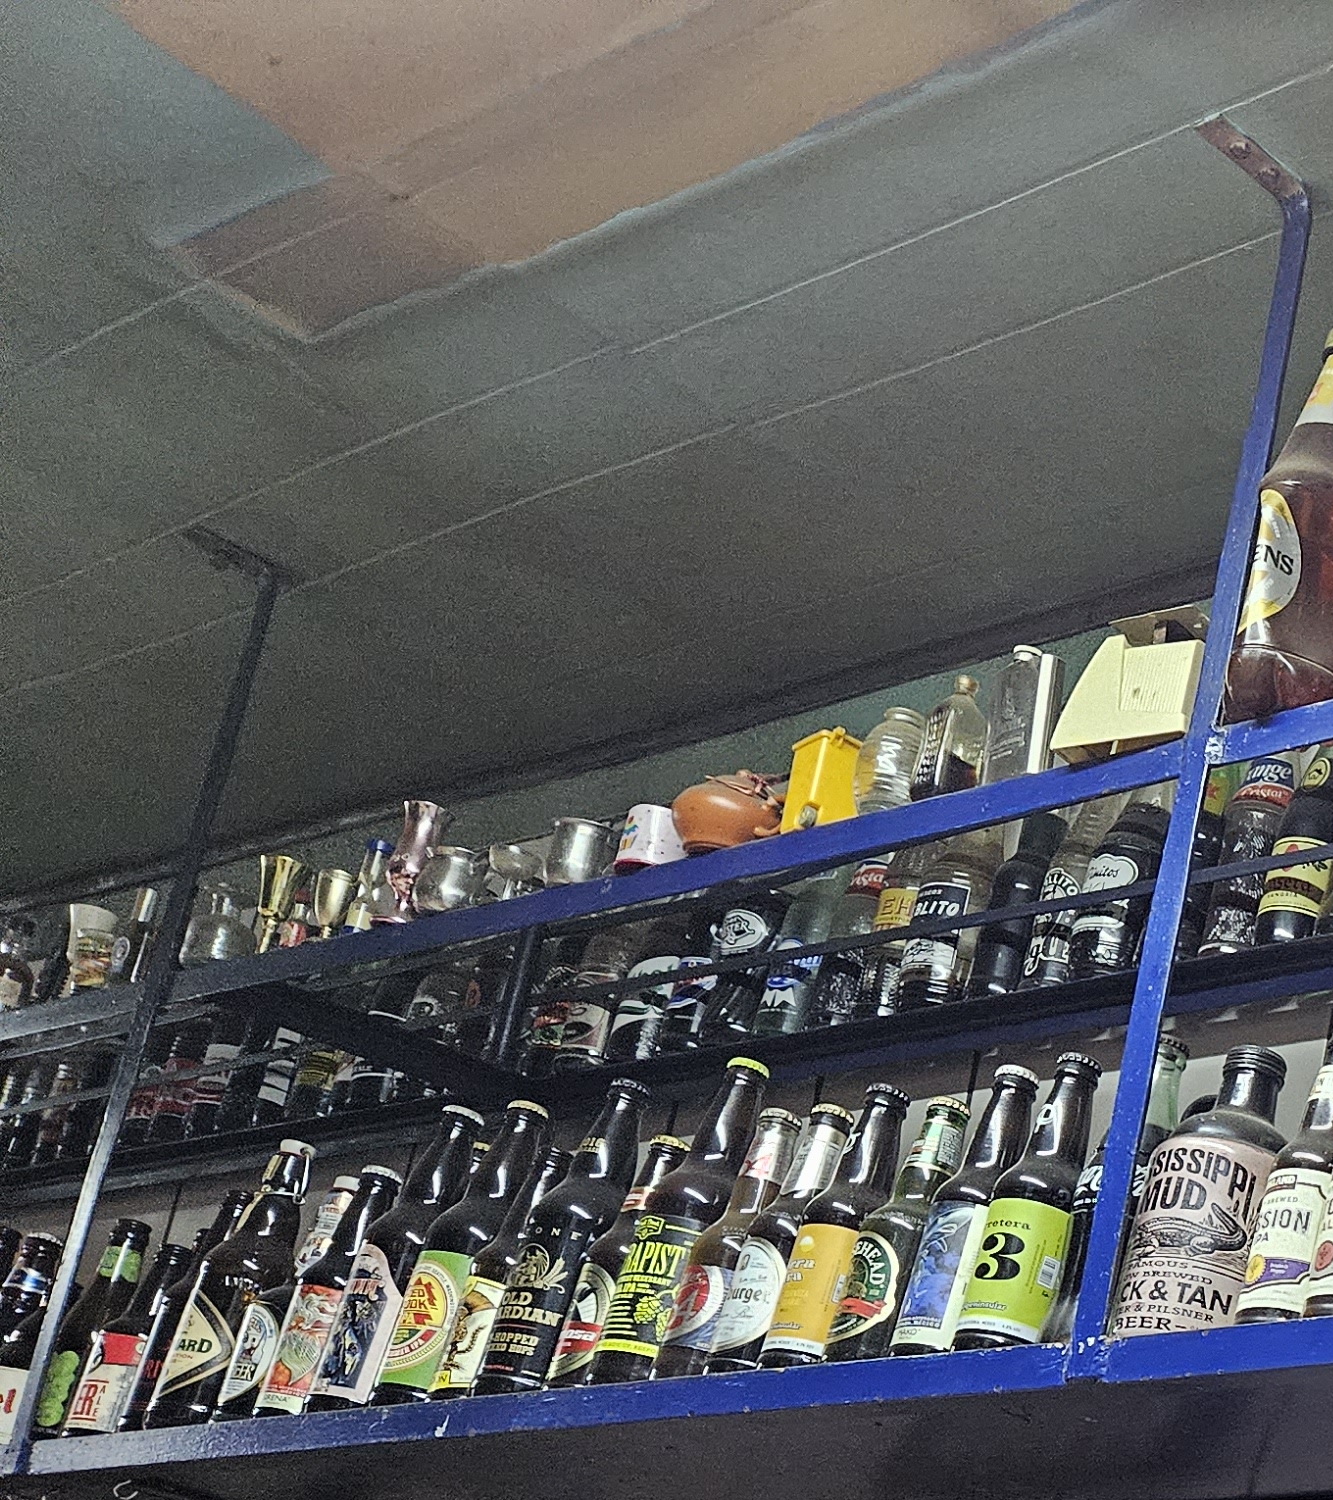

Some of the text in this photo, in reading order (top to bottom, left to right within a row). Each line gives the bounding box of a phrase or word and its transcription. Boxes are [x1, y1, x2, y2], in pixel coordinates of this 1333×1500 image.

[974, 1232, 1027, 1281] 3
[1148, 1279, 1233, 1316] & TAN
[1148, 1303, 1214, 1324] PILSNER
